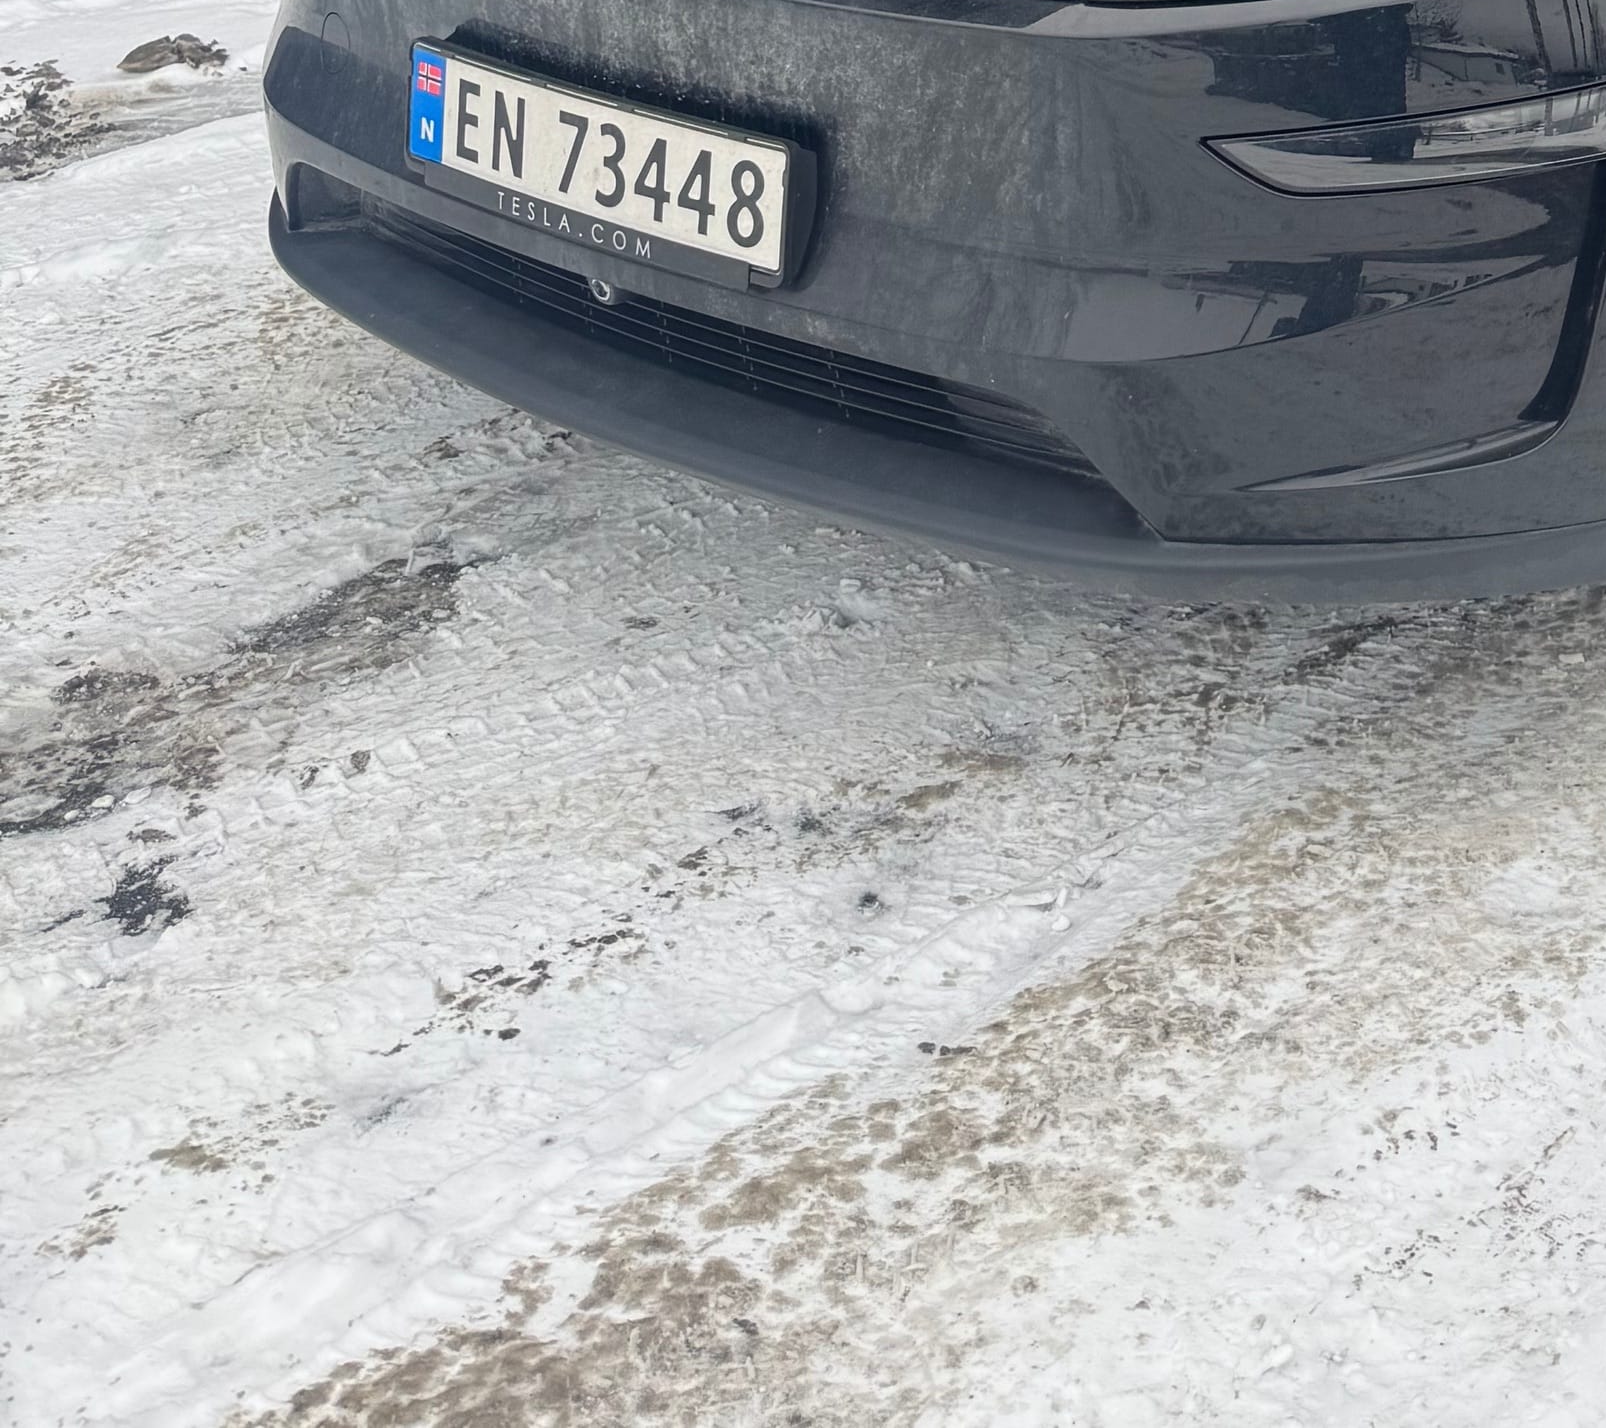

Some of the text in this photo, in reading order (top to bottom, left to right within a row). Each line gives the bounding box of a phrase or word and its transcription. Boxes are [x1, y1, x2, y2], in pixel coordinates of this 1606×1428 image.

[419, 117, 435, 143] N
[455, 77, 766, 249] EN 73448
[498, 191, 651, 259] TESLA.COM
